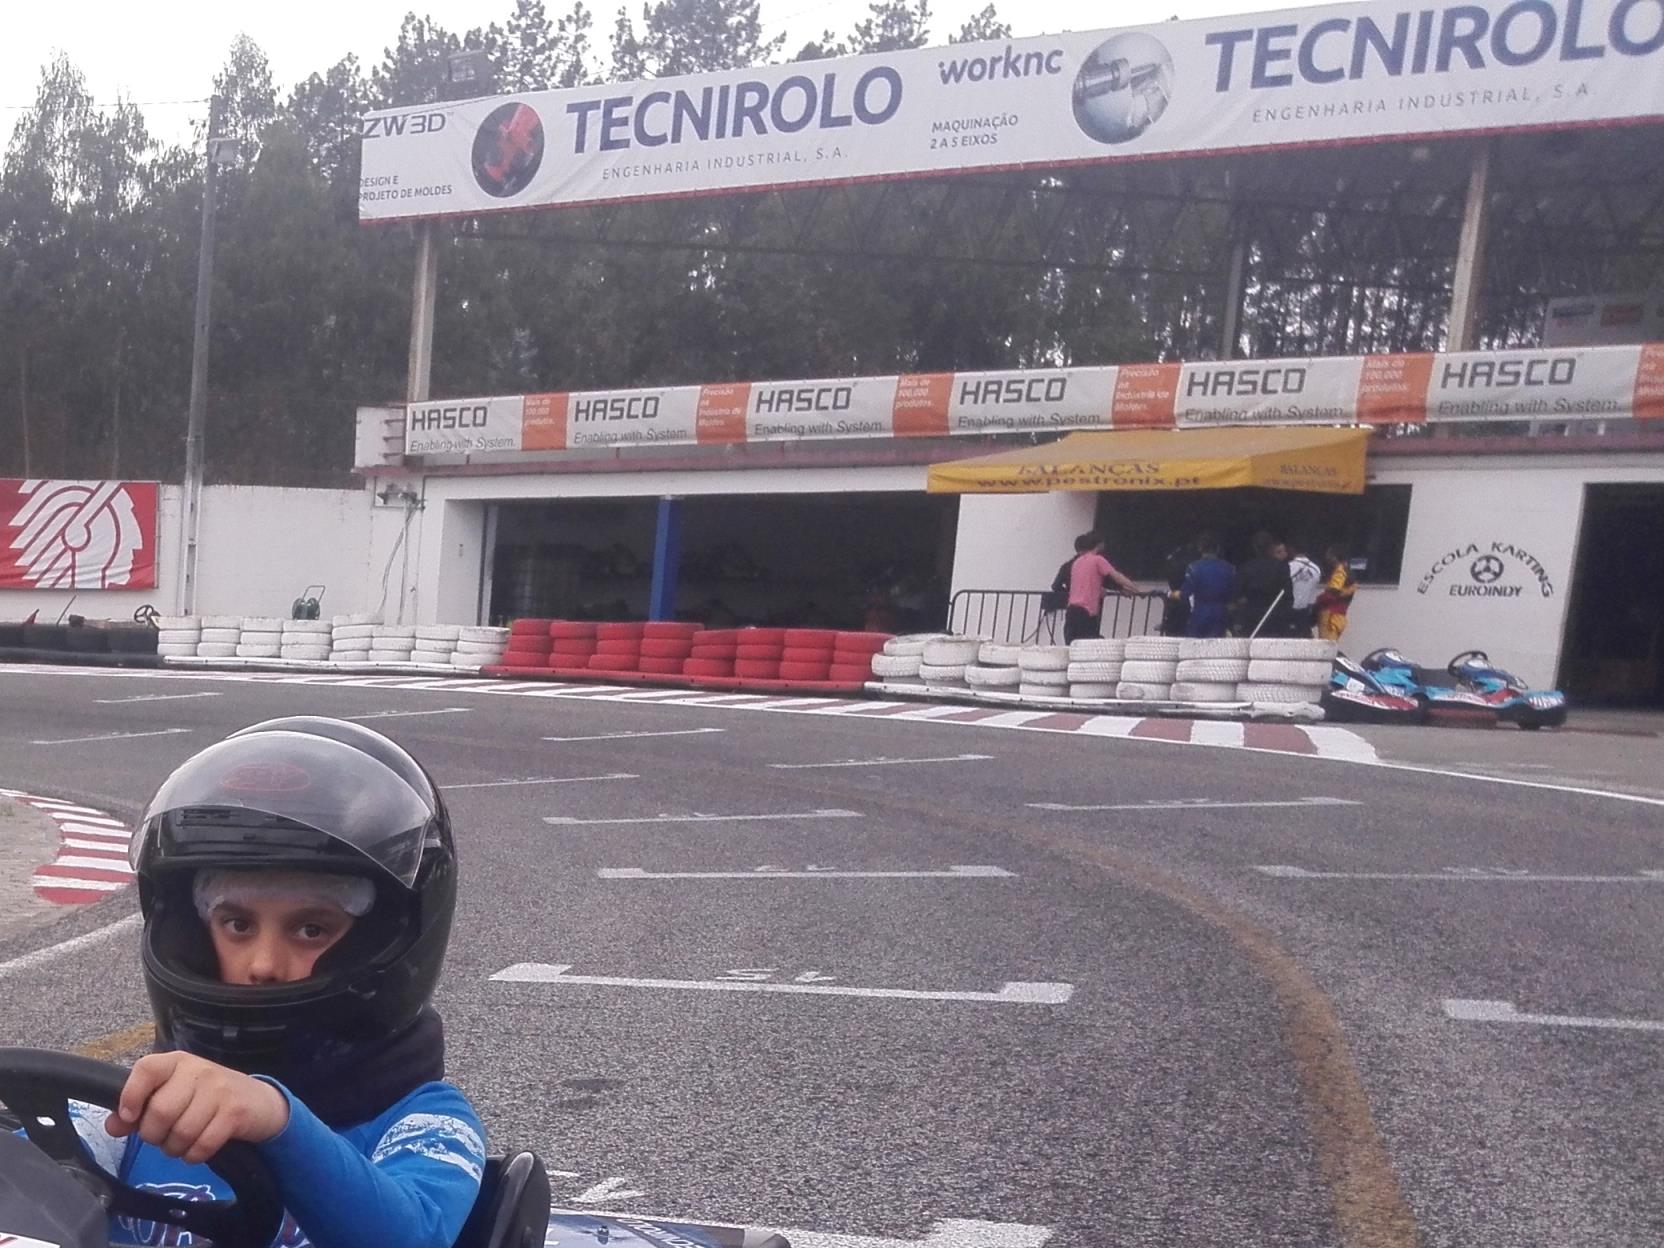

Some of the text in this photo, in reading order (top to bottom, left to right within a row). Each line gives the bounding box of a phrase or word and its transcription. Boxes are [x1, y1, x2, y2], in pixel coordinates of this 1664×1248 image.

[1205, 0, 1664, 92] TECNIROLO
[566, 66, 903, 154] TECNIROLO
[1252, 98, 1387, 123] ENGENHARIA
[362, 112, 447, 139] ZW3D
[931, 113, 1018, 132] MAQUINAÇÃO
[930, 134, 998, 149] 2 A 5 EIXOS
[602, 159, 700, 180] ENGENHARIA
[400, 187, 412, 198] DE
[414, 184, 453, 197] MOLDES
[1187, 368, 1306, 397] HASCO
[1441, 358, 1576, 388] HASCO
[756, 387, 852, 413] HASCO
[960, 377, 1067, 405] HASCO
[411, 405, 488, 431] HASCO
[575, 396, 660, 422] HASCO
[1185, 407, 1247, 423] Enabling
[1251, 406, 1282, 420] with
[1438, 401, 1509, 417] Enabling
[1515, 398, 1548, 413] with
[755, 423, 805, 437] Enabling
[808, 422, 833, 434] with
[958, 415, 1014, 429] Enabling
[1018, 414, 1044, 427] with
[411, 439, 453, 454] Enabling
[454, 437, 473, 450] with
[574, 430, 621, 446] Enabling
[622, 430, 643, 442] with
[1416, 541, 1554, 598] ESCOLA KARTING
[1448, 584, 1523, 598] EUROINDY
